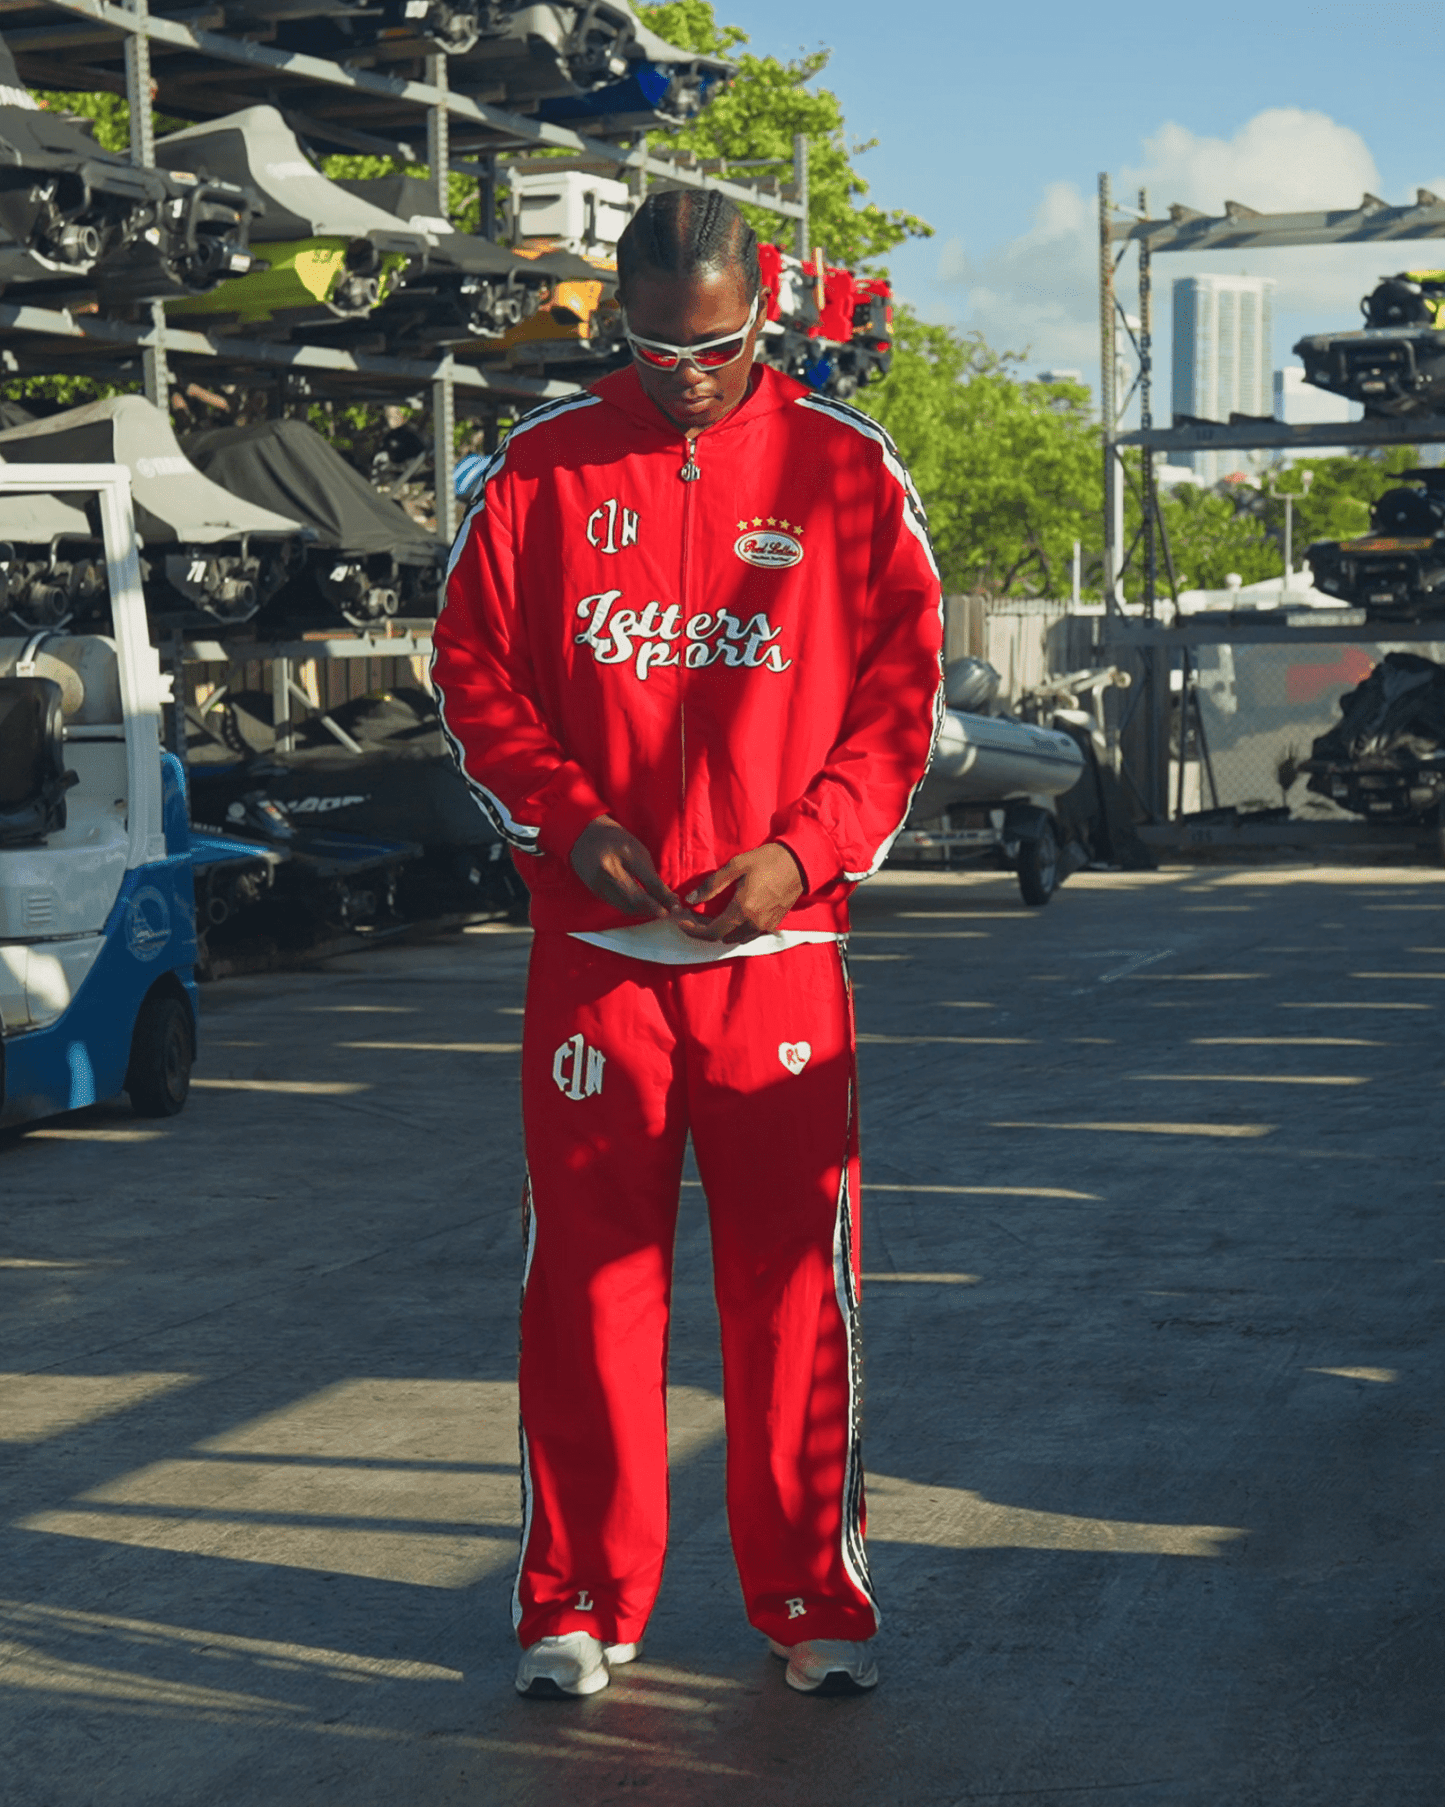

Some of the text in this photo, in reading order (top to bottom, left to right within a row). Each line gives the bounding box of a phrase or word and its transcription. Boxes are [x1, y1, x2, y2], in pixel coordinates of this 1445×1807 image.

[575, 589, 782, 651] Letters
[594, 613, 793, 680] Sports
[786, 1048, 806, 1066] RL
[575, 1591, 593, 1611] L
[785, 1598, 807, 1619] R
